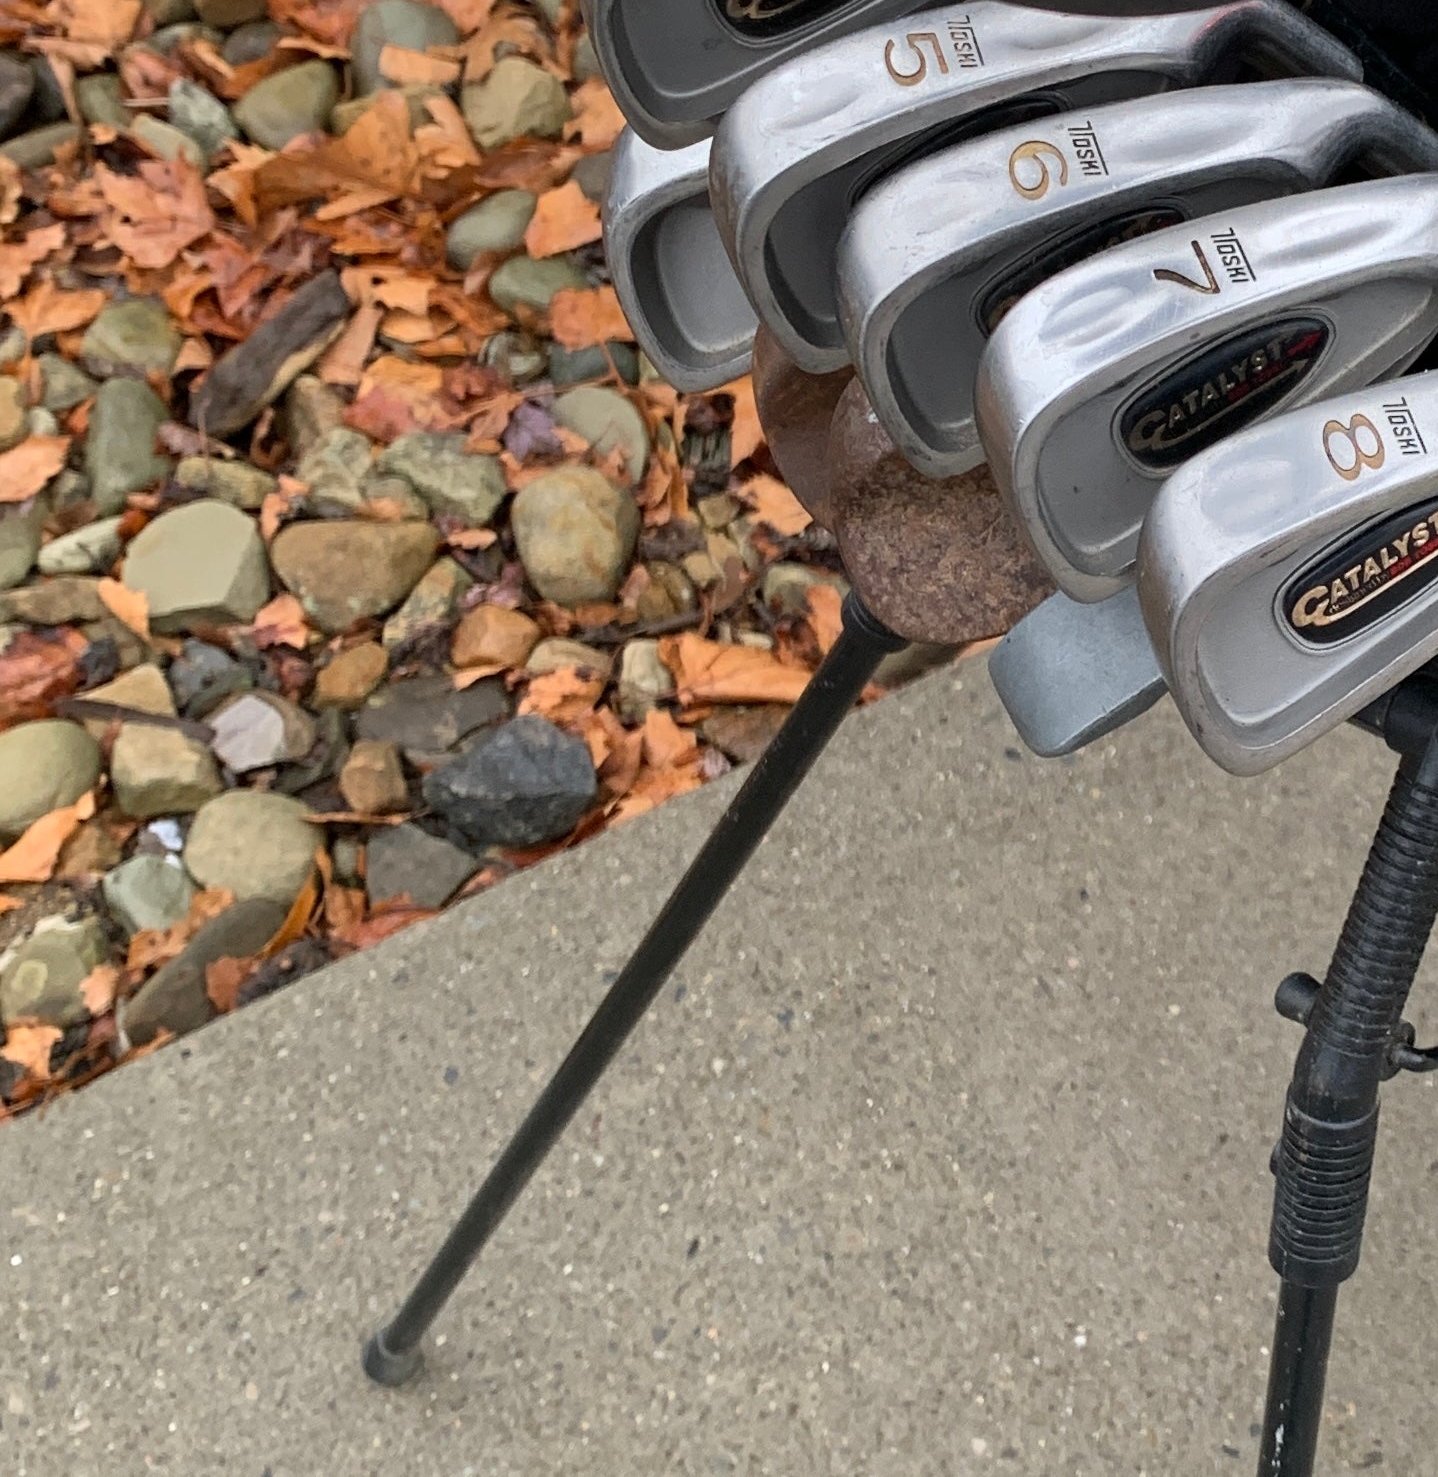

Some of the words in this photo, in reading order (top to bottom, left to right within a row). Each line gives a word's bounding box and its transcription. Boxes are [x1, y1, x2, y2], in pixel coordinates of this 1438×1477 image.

[884, 31, 949, 87] 5
[946, 14, 985, 69] TOSKI
[1008, 139, 1069, 201] 6
[1066, 120, 1110, 177] TOSKI
[1152, 239, 1222, 296] 7
[1209, 226, 1257, 284] TOSKI
[1128, 328, 1300, 451] CATALYST
[1322, 412, 1387, 481] 8
[1382, 396, 1428, 456] TOSKI
